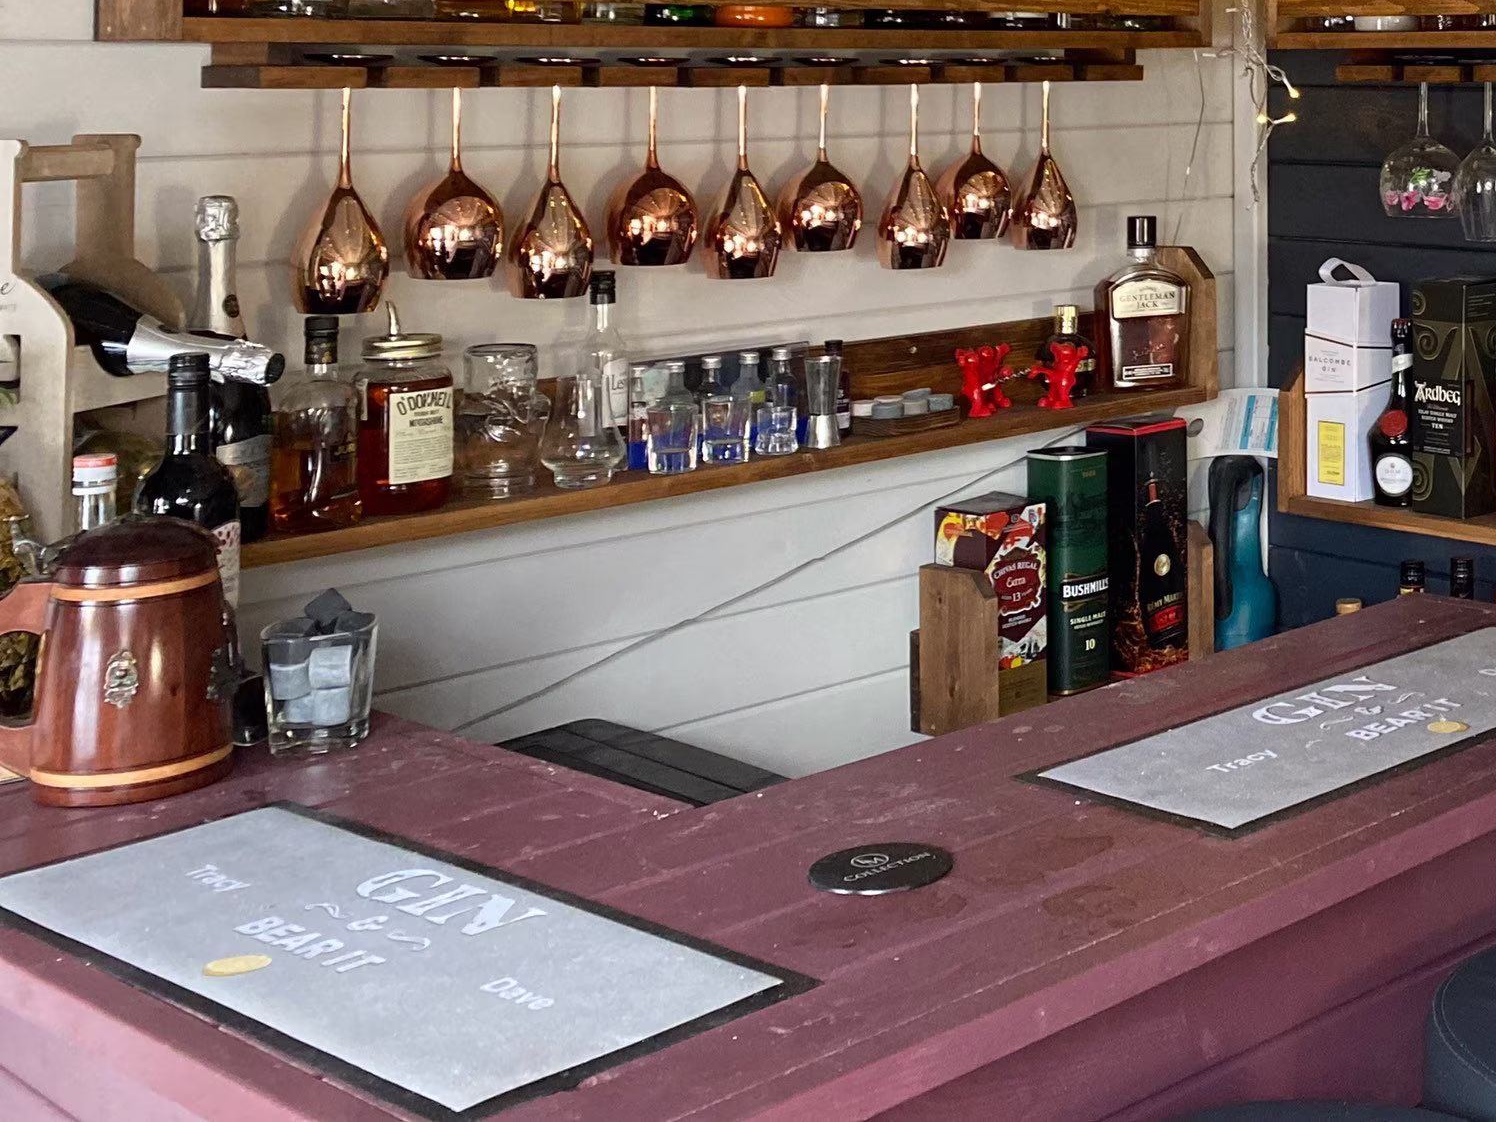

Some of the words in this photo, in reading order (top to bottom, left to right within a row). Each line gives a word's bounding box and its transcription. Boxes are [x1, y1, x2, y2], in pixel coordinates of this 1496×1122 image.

[1119, 291, 1176, 302] GENTLEMAN
[1309, 355, 1351, 366] SALCOMBE
[1431, 422, 1444, 430] TEN
[1085, 638, 1096, 651] 10
[1252, 675, 1398, 726] GIN
[1345, 707, 1434, 741] BEAR
[1423, 697, 1463, 712] IT
[1206, 748, 1279, 774] Tracy
[185, 863, 251, 892] Tracy
[843, 851, 932, 882] COLLECTION
[356, 868, 549, 936] GIN
[233, 916, 344, 960] BEAR
[320, 949, 387, 974] IT
[479, 976, 555, 1011] Dave
